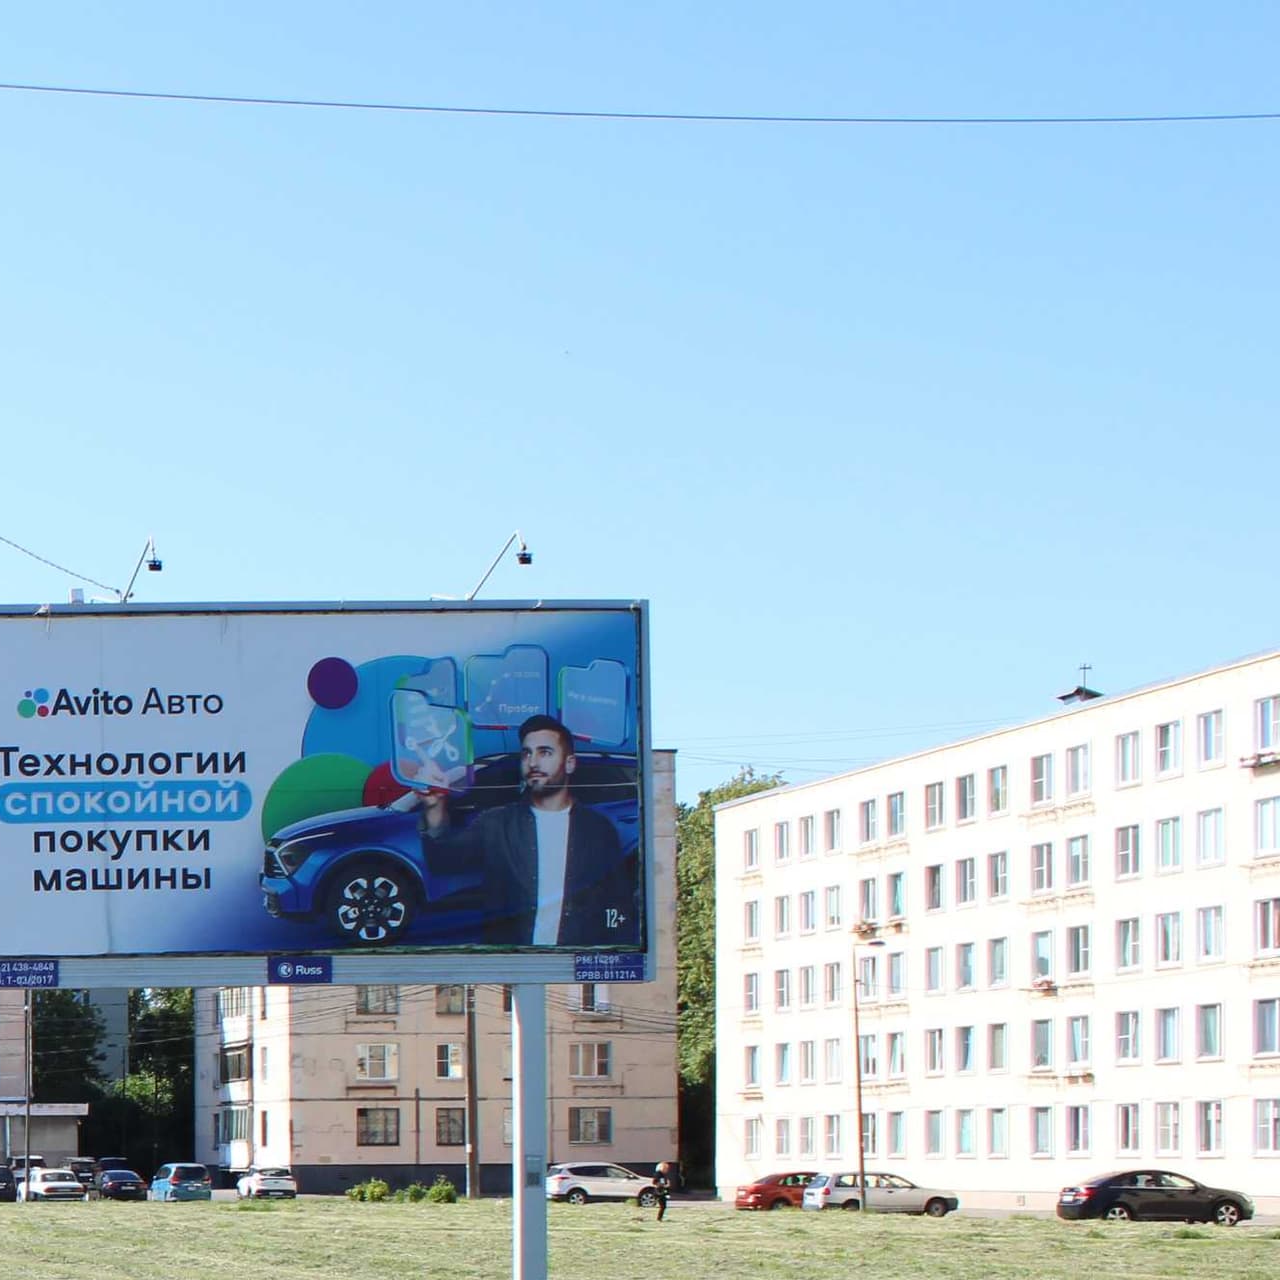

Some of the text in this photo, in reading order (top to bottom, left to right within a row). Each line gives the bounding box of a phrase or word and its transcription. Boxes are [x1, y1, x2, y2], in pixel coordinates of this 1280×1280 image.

[50, 687, 224, 716] Avito Авто
[498, 703, 540, 715] Пробег
[3, 780, 239, 816] спокойной
[33, 829, 211, 861] покупки
[33, 867, 212, 892] машины
[605, 908, 626, 929] 12+
[12, 962, 55, 972] 438-4848
[295, 964, 323, 976] Russ
